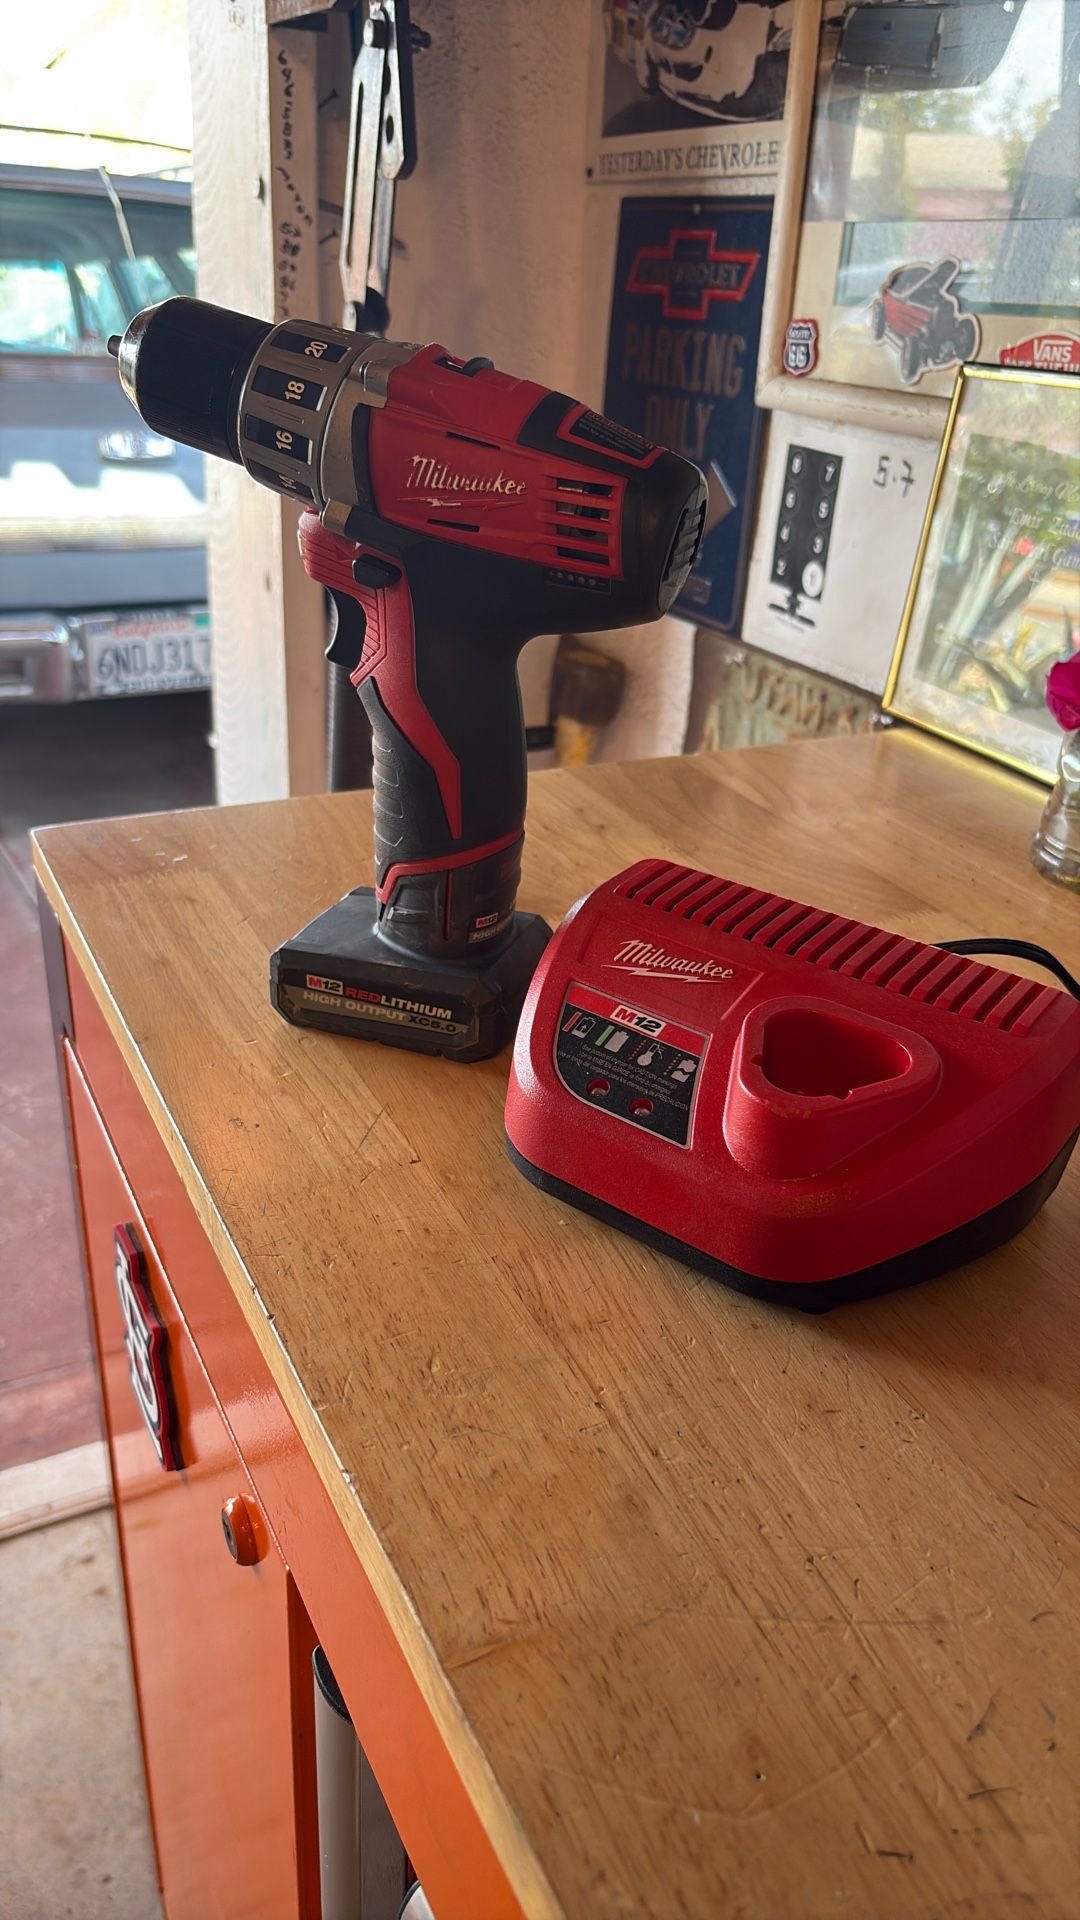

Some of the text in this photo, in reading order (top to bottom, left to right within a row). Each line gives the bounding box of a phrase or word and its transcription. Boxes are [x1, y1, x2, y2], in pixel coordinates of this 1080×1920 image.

[685, 140, 781, 172] CHEVROLE
[304, 341, 328, 358] 20
[622, 323, 746, 399] PARKING
[788, 344, 808, 368] 66
[1033, 338, 1073, 363] VANS
[284, 380, 305, 400] 18
[275, 430, 293, 450] 16
[646, 394, 716, 461] ONLY
[278, 473, 297, 490] 14
[406, 455, 529, 495] Milwaukee
[825, 462, 836, 483] 7
[872, 455, 914, 499] 5.7
[818, 500, 829, 520] 5
[813, 534, 824, 555] 3
[613, 940, 734, 979] Milwaukee
[308, 975, 453, 1020] M12 REDLITHIUM
[303, 991, 457, 1033] HIGH OUTPUT XC5.0
[614, 1007, 662, 1033] M12
